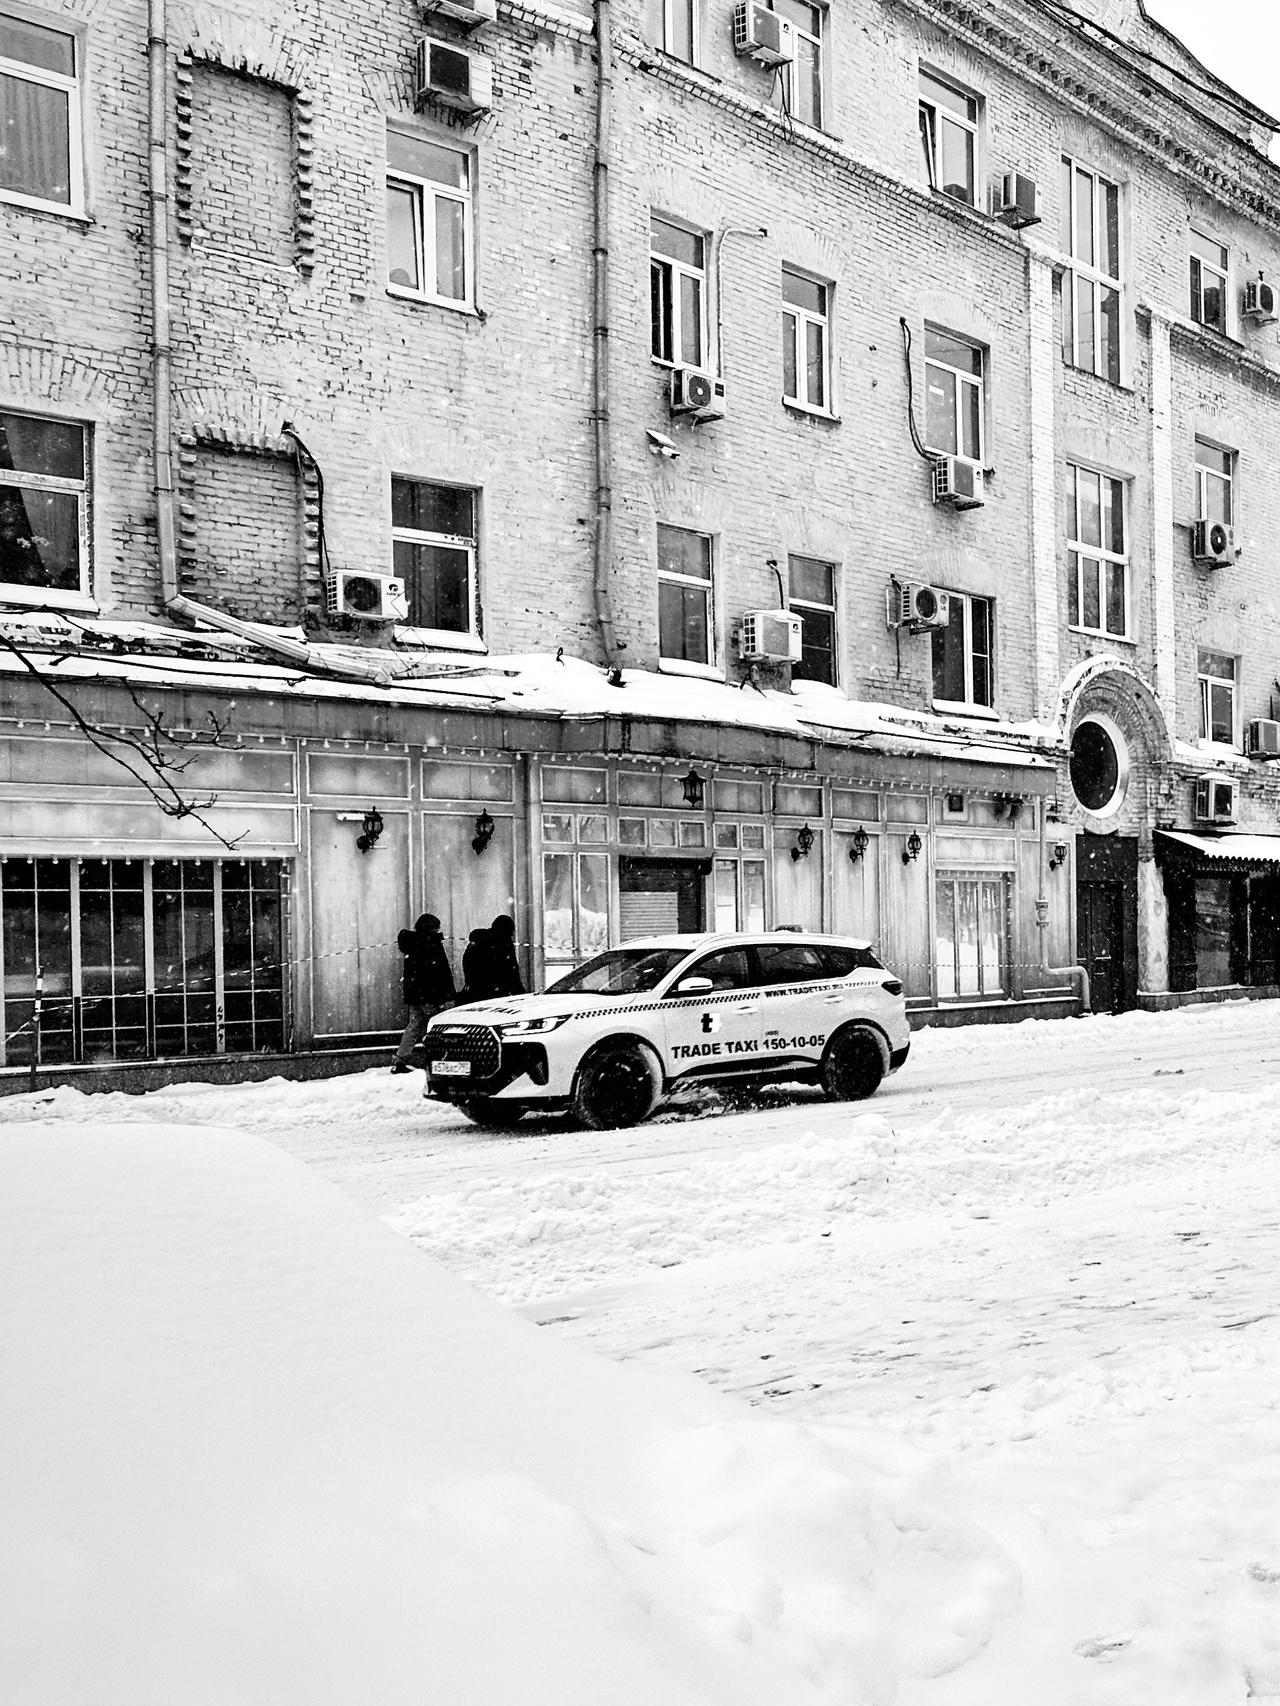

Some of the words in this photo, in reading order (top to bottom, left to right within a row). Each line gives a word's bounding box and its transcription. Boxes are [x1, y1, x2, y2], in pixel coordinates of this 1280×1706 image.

[671, 1043, 721, 1059] TRADE
[725, 1040, 758, 1053] TAXI
[763, 1035, 825, 1050] 150-10-05
